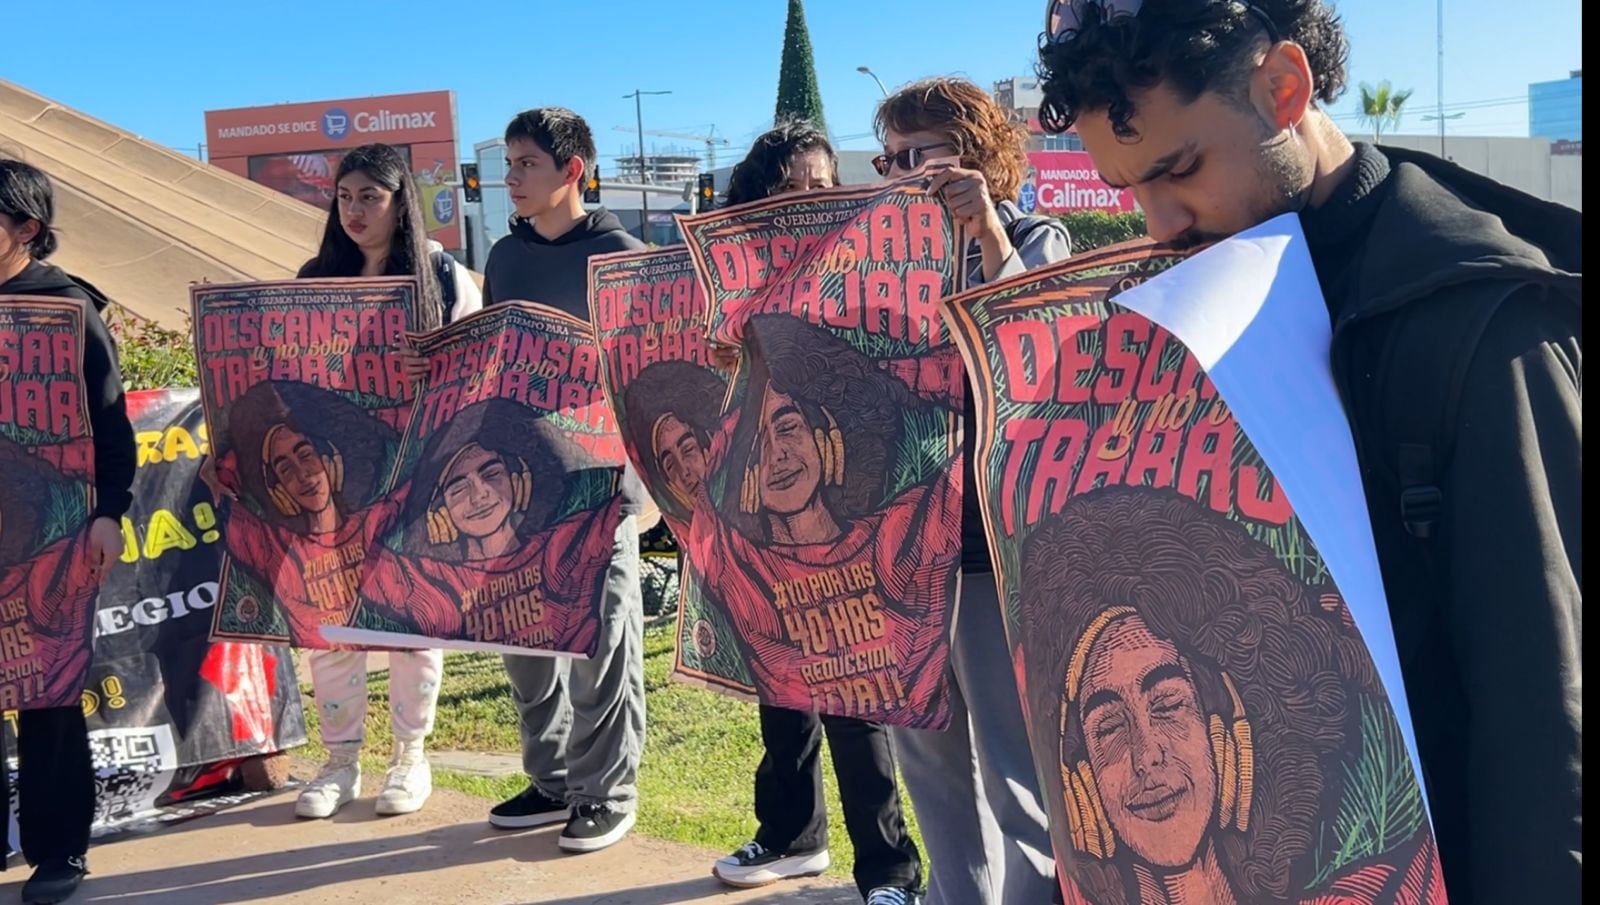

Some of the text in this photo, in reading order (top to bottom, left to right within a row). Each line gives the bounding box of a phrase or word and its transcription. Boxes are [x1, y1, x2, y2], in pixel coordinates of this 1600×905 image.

[218, 120, 317, 139] MANDADO SE DICE
[354, 110, 436, 133] Calimax
[1040, 169, 1089, 180] MANDADO
[1037, 182, 1121, 208] Calimax
[773, 212, 834, 229] QUEREMOS
[639, 262, 681, 277] QUEREMOS
[247, 294, 353, 307] QUEREMOS TIEMPO PARA
[203, 308, 406, 352] DESCANSAR
[507, 315, 545, 331] TIEMPO
[545, 323, 569, 336] PARA
[276, 342, 300, 359] no
[310, 335, 350, 356] solo
[513, 358, 559, 379] solo
[1146, 388, 1198, 433] no
[343, 542, 366, 564] LAS
[489, 572, 518, 600] POR
[517, 564, 542, 588] LAS
[807, 568, 845, 601] POR
[842, 561, 876, 591] LAS
[307, 577, 335, 611] 40
[465, 607, 498, 642] 40
[783, 608, 828, 657] 40
